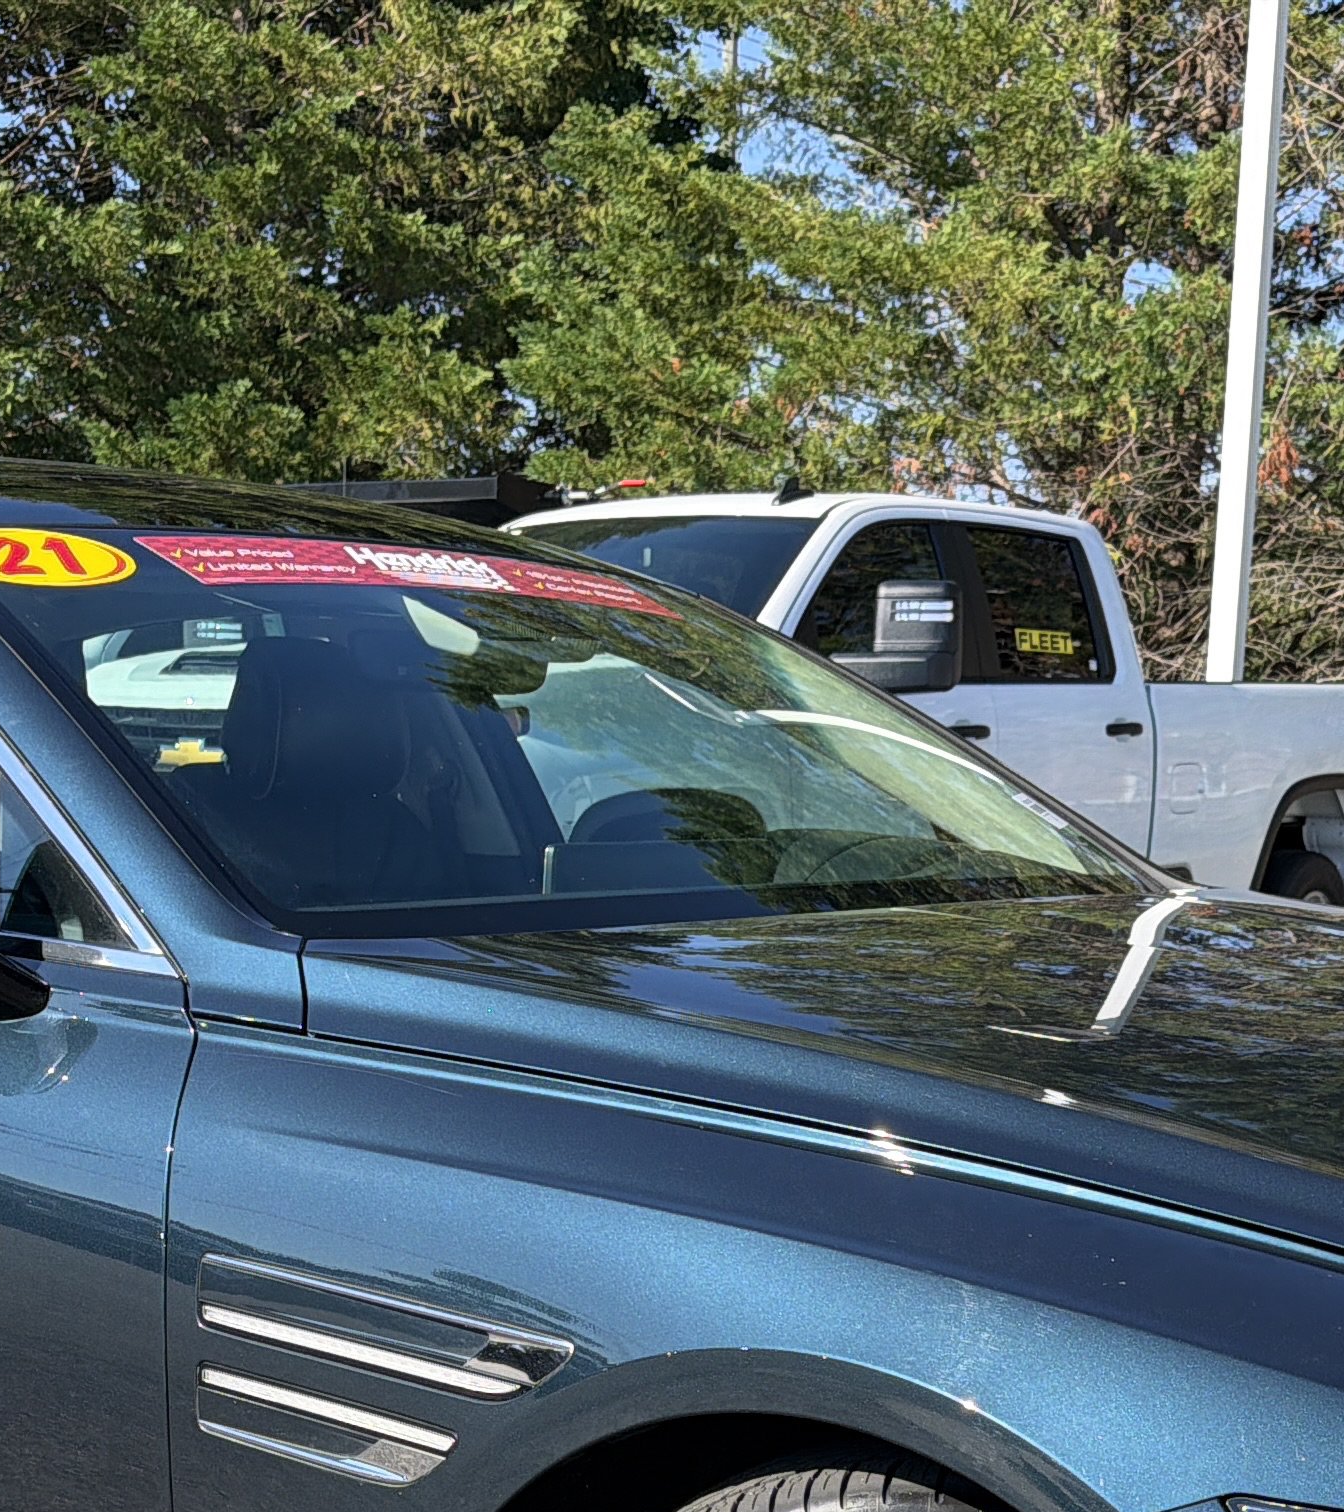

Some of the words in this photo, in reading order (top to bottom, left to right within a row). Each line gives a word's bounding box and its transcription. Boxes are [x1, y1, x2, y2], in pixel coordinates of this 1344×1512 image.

[184, 548, 235, 559] Value
[207, 562, 274, 572] Limited
[275, 562, 357, 574] Warranty
[343, 545, 504, 580] Hendrick
[1018, 631, 1071, 653] FLEET
